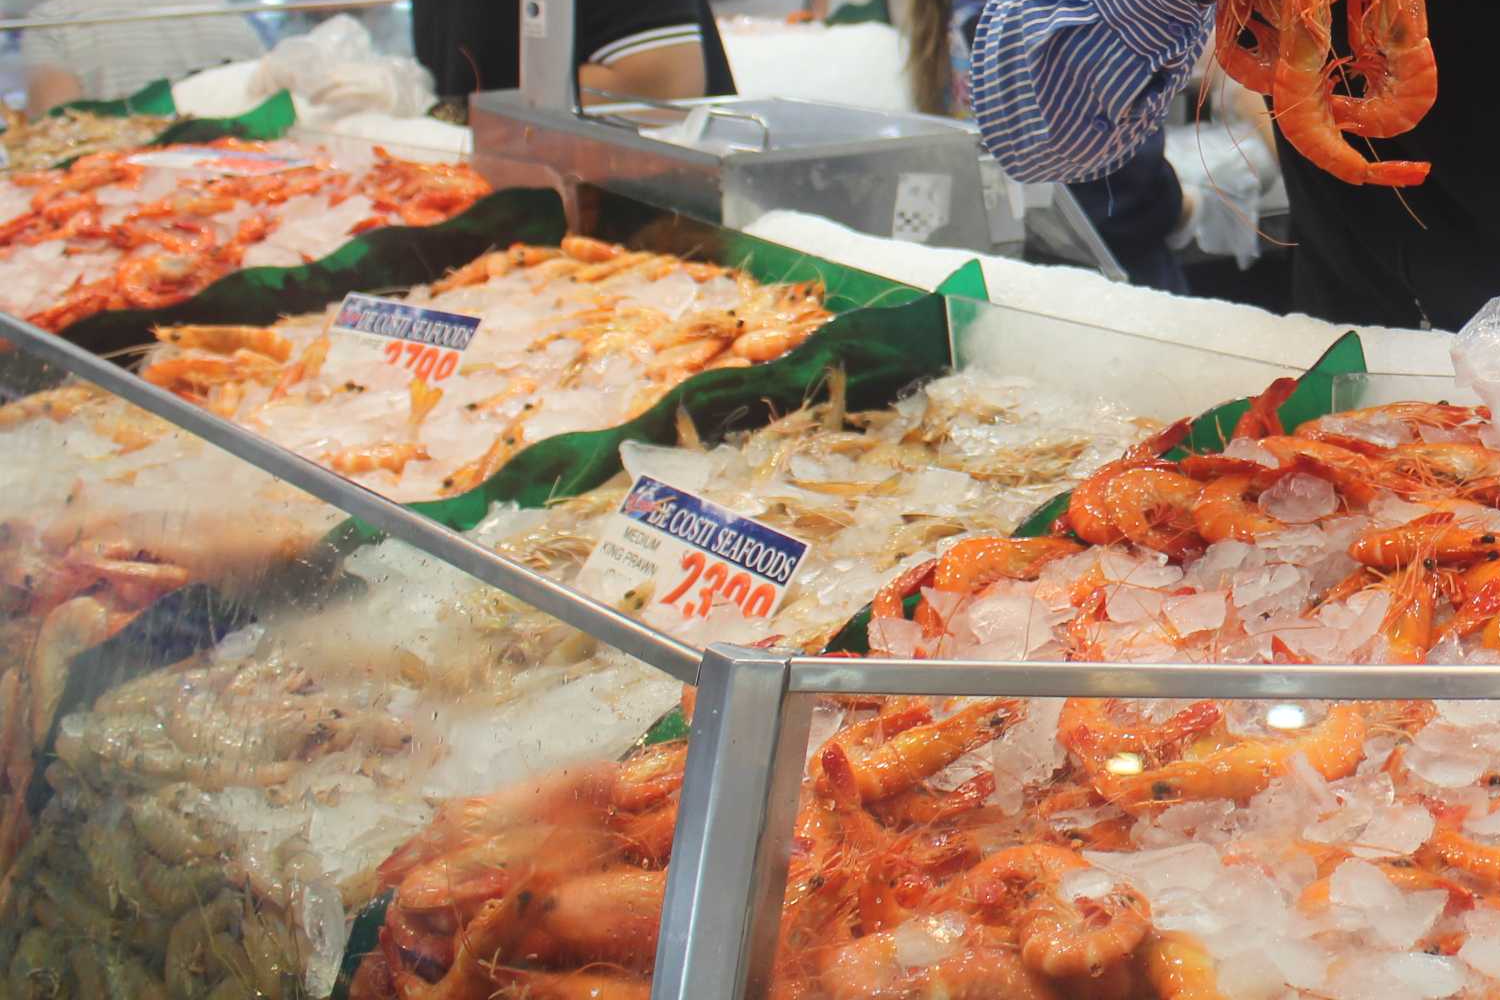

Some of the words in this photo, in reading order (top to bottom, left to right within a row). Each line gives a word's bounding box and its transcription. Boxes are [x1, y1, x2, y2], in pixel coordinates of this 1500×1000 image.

[647, 502, 677, 528] DE
[670, 507, 719, 549] COSTI
[711, 527, 797, 583] SEAFOODS
